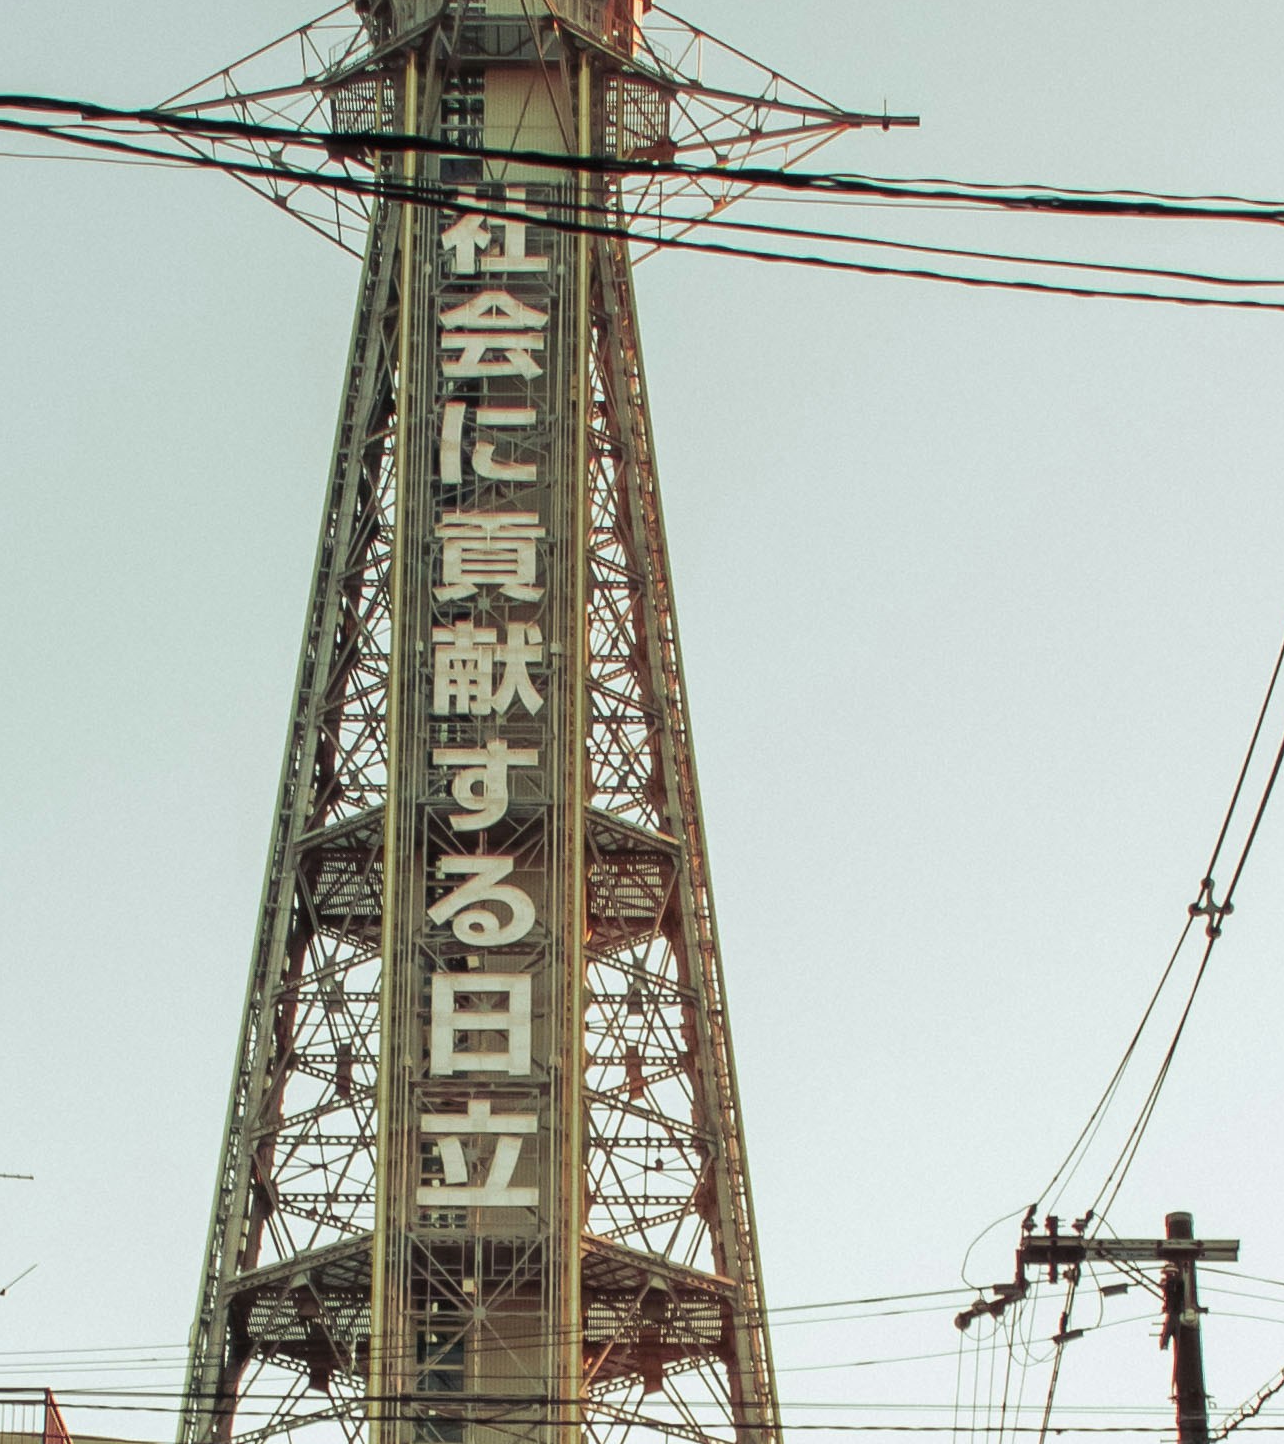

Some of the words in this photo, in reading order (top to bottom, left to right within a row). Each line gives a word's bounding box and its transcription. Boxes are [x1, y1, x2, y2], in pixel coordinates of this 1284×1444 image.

[415, 184, 551, 1211] 社会に貢献する日立
